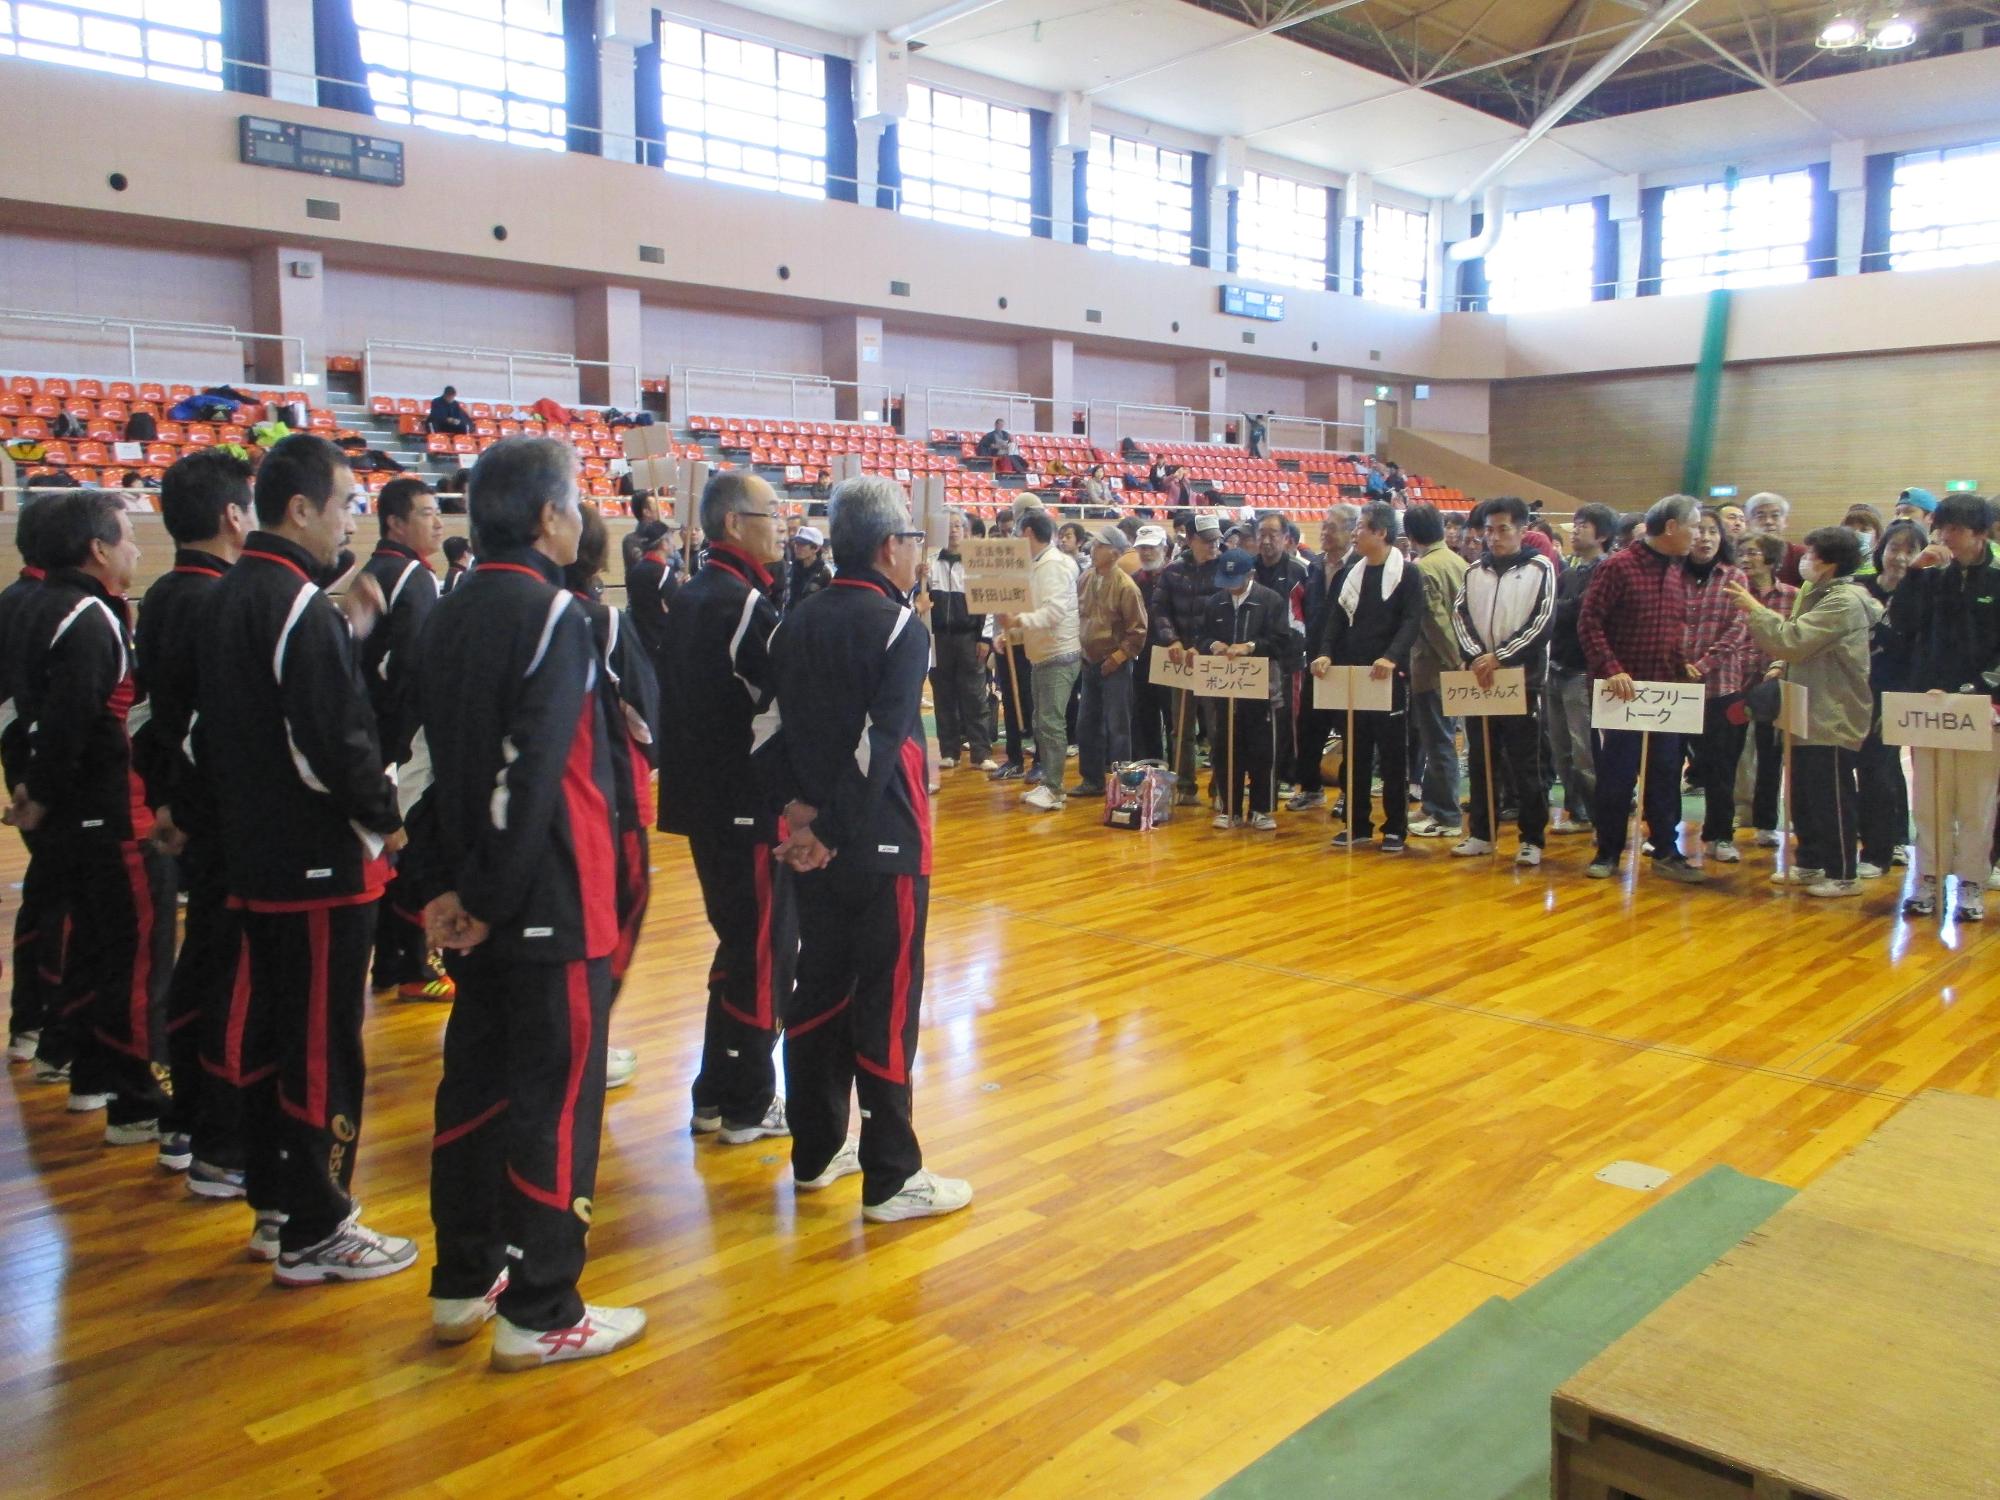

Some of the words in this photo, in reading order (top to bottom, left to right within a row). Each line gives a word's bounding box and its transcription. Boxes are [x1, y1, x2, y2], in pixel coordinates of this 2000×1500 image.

[971, 587, 1026, 603] 野田山町
[1199, 660, 1263, 676] ゴールデン
[1206, 676, 1256, 690] ボンバー
[1601, 687, 1700, 706] ウズフリー
[1625, 706, 1672, 724] トーク
[1898, 711, 1976, 731] JTHBA
